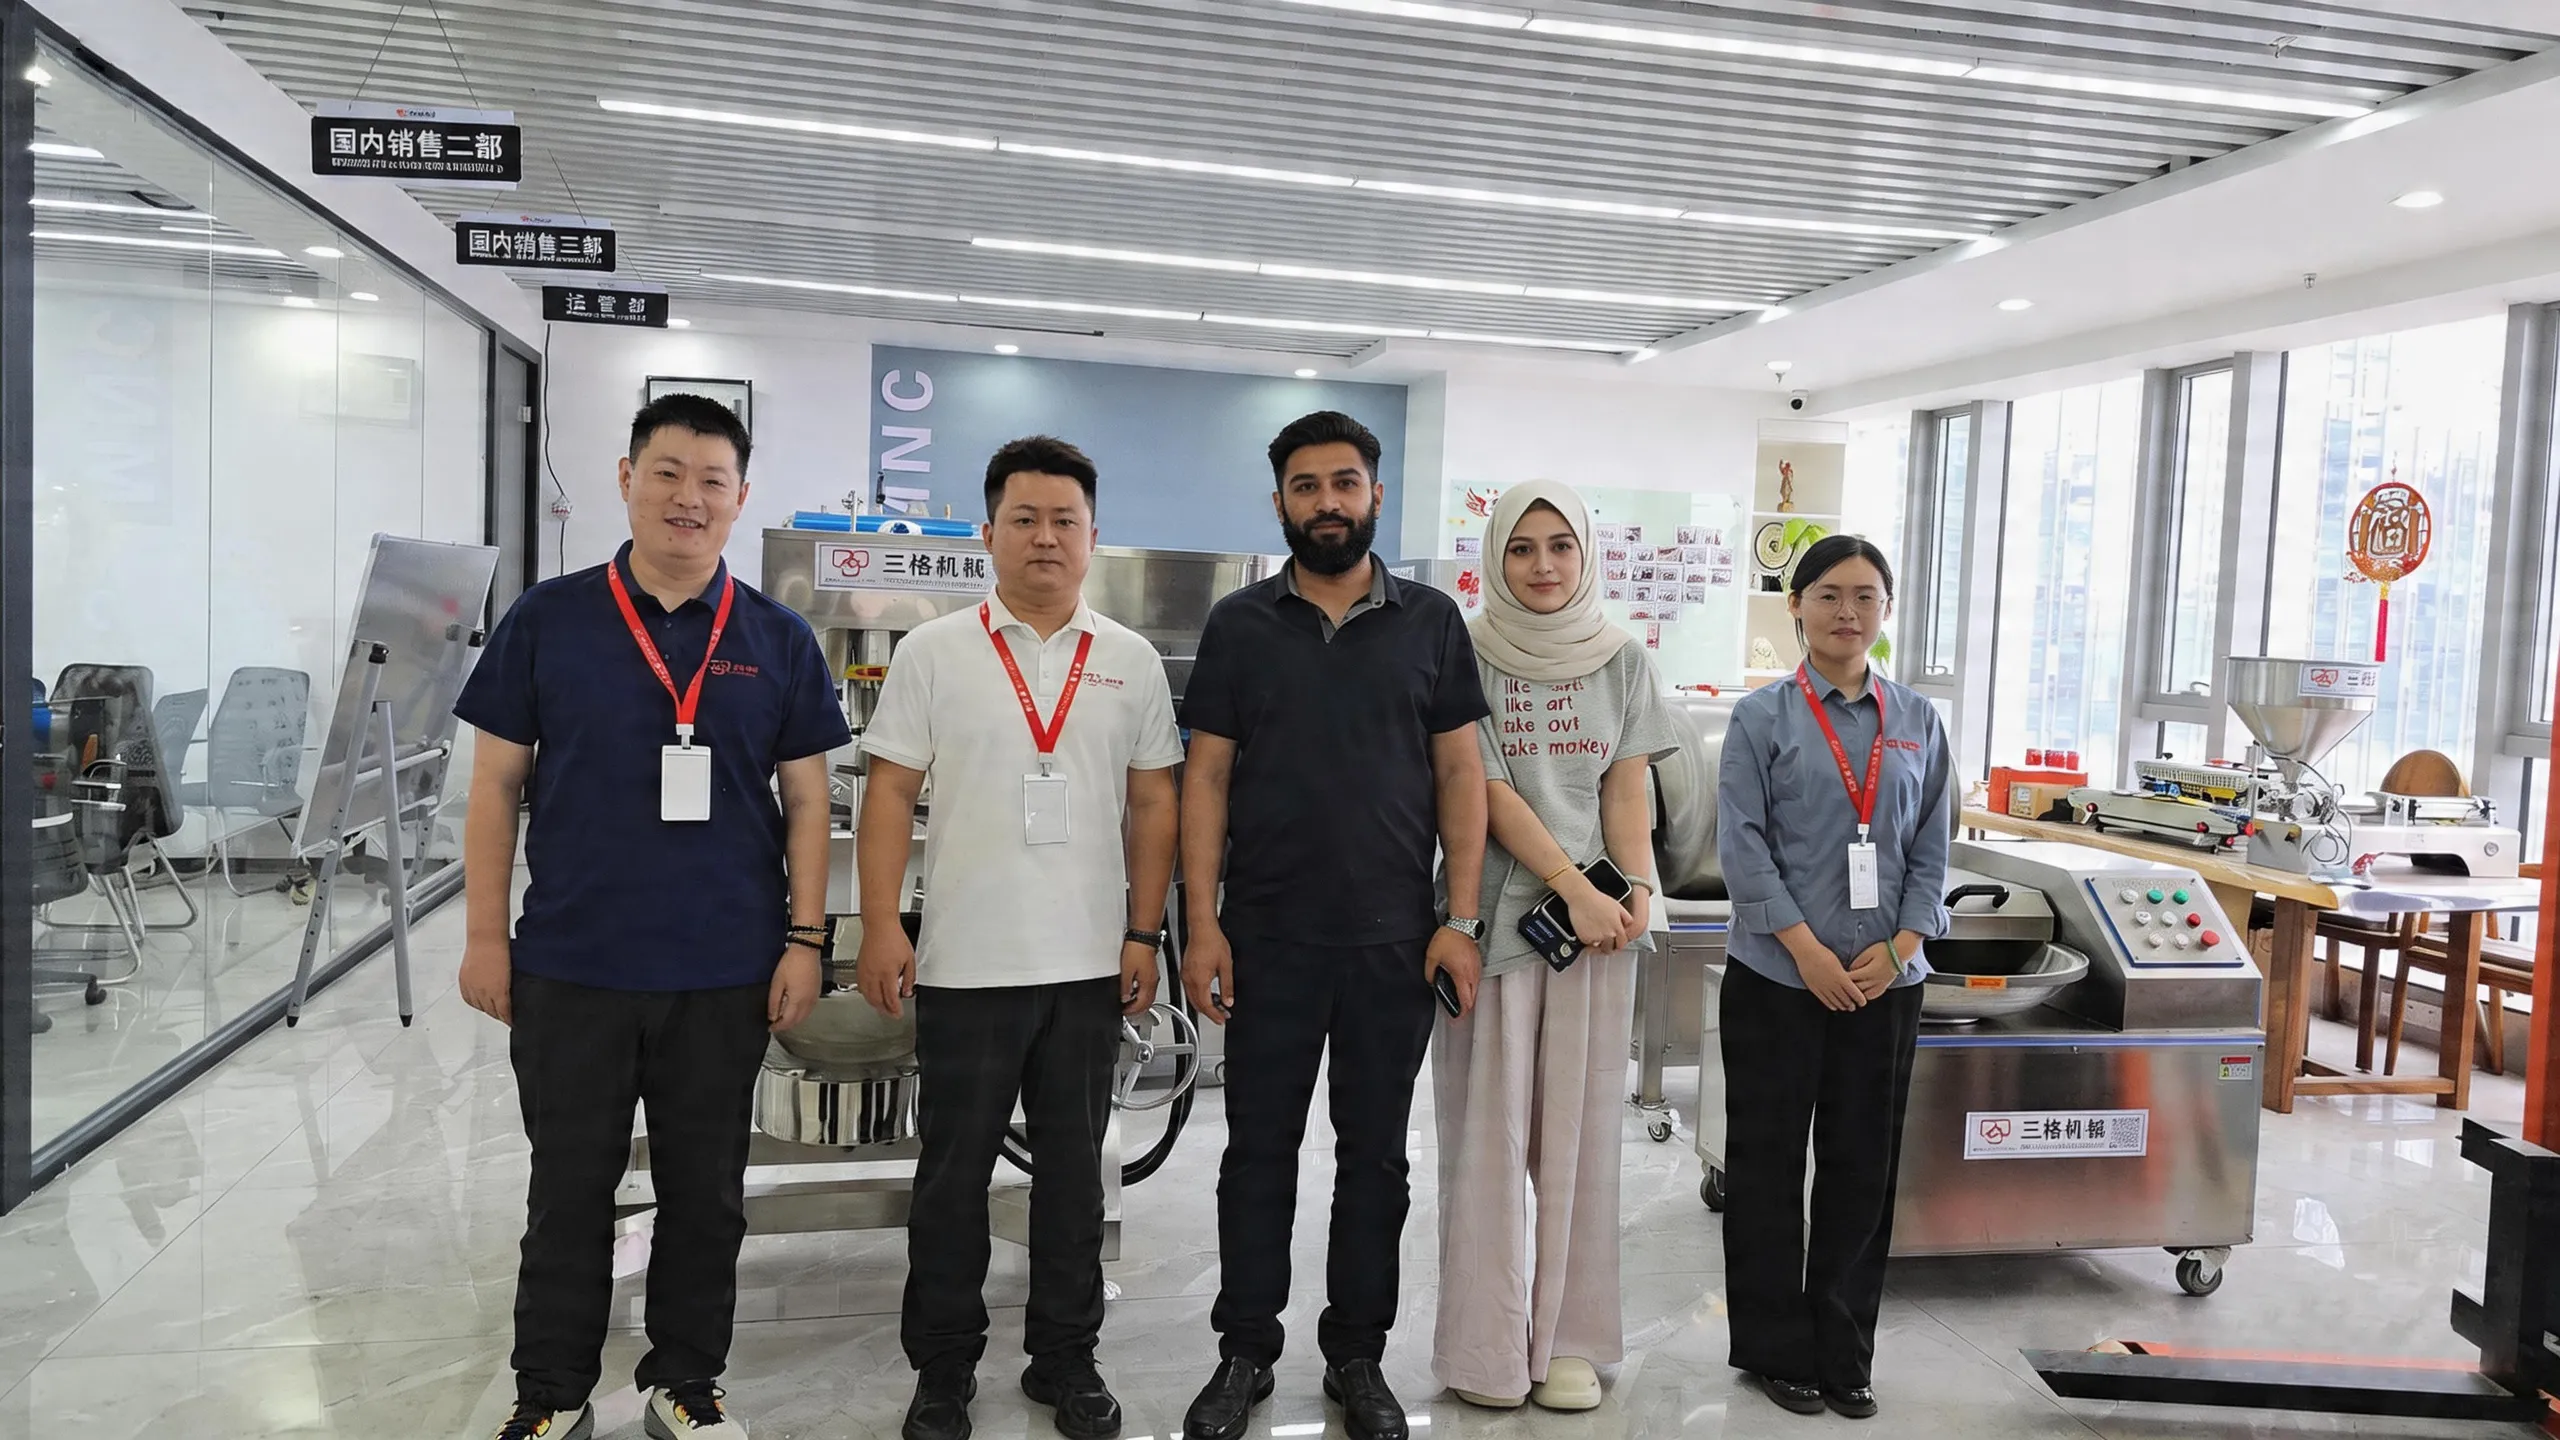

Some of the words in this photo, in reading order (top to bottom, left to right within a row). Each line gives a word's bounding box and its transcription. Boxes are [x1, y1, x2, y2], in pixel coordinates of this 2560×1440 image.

[330, 127, 503, 160] 国内销售二部
[1547, 695, 1573, 711] art
